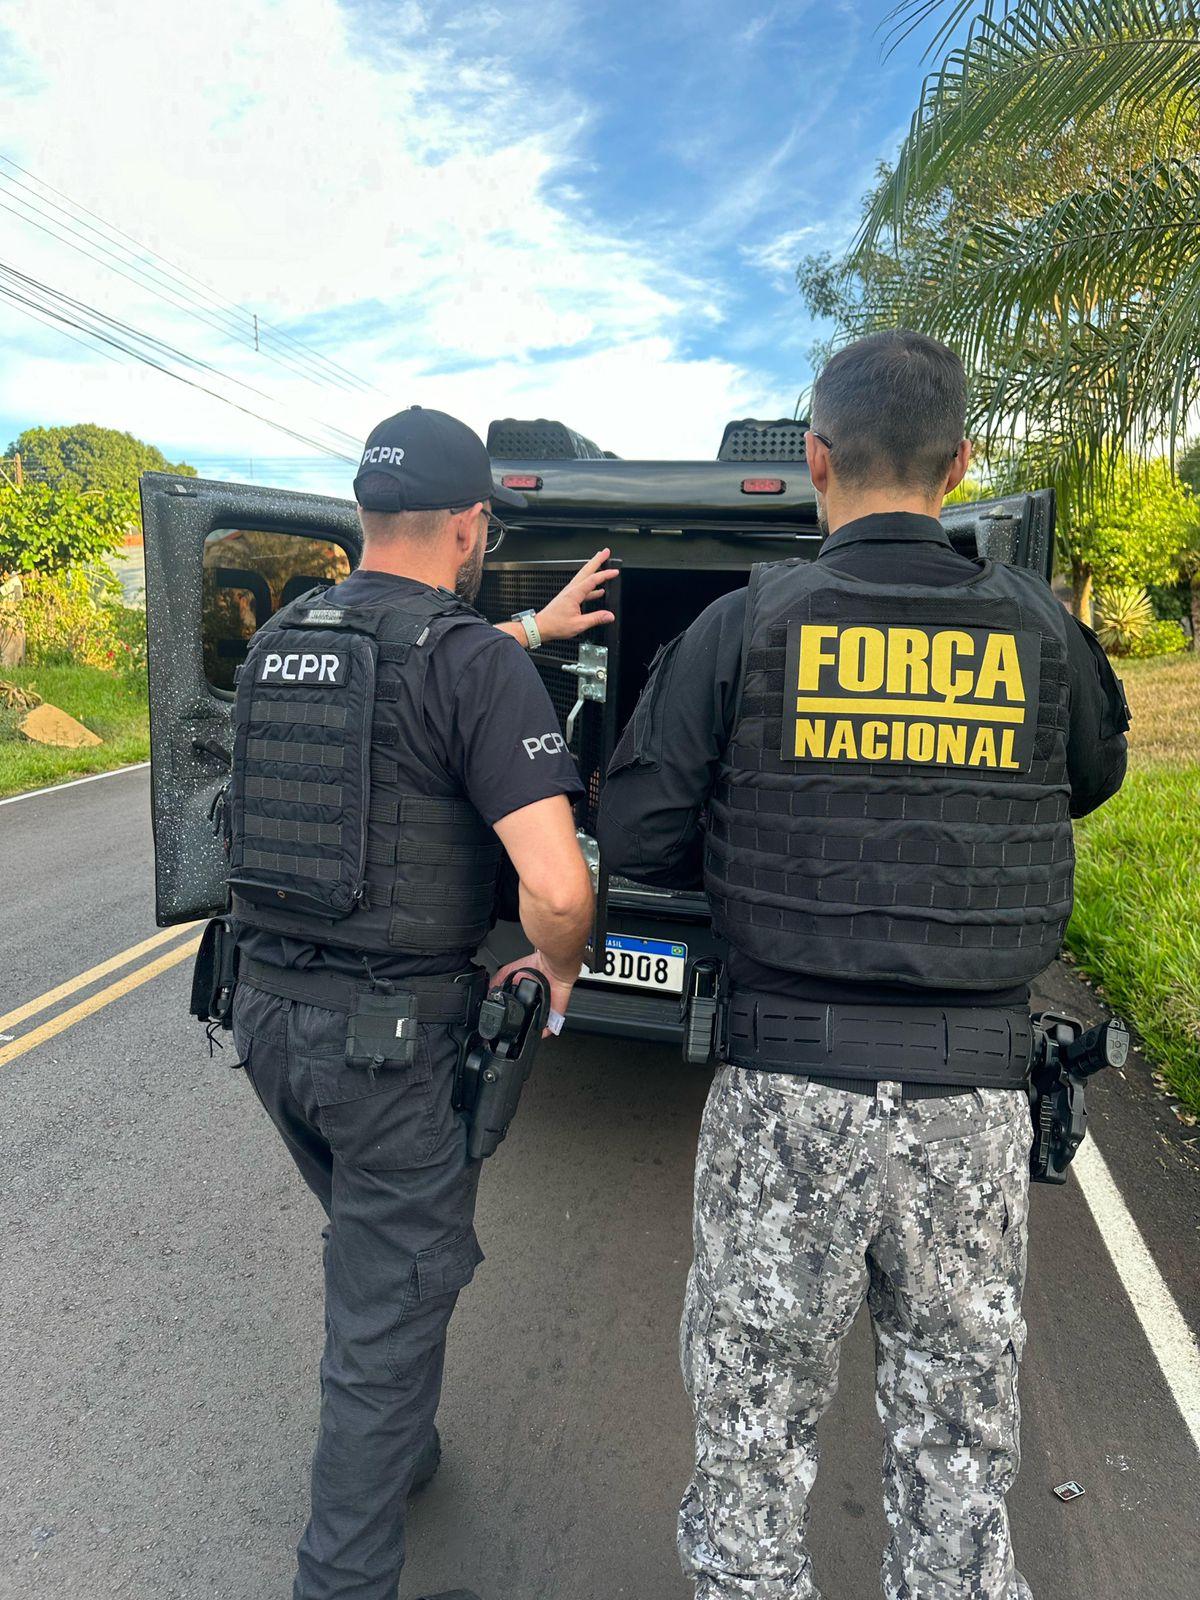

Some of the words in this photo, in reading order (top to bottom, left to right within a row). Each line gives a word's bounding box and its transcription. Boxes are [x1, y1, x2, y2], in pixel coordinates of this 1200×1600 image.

[362, 446, 405, 466] PCPR
[261, 653, 340, 682] PCPR
[798, 624, 1026, 704] FORÇA
[521, 732, 570, 760] PCP
[794, 718, 1020, 769] NACIONAL
[605, 939, 623, 949] ASIL
[603, 951, 669, 984] 8D08
